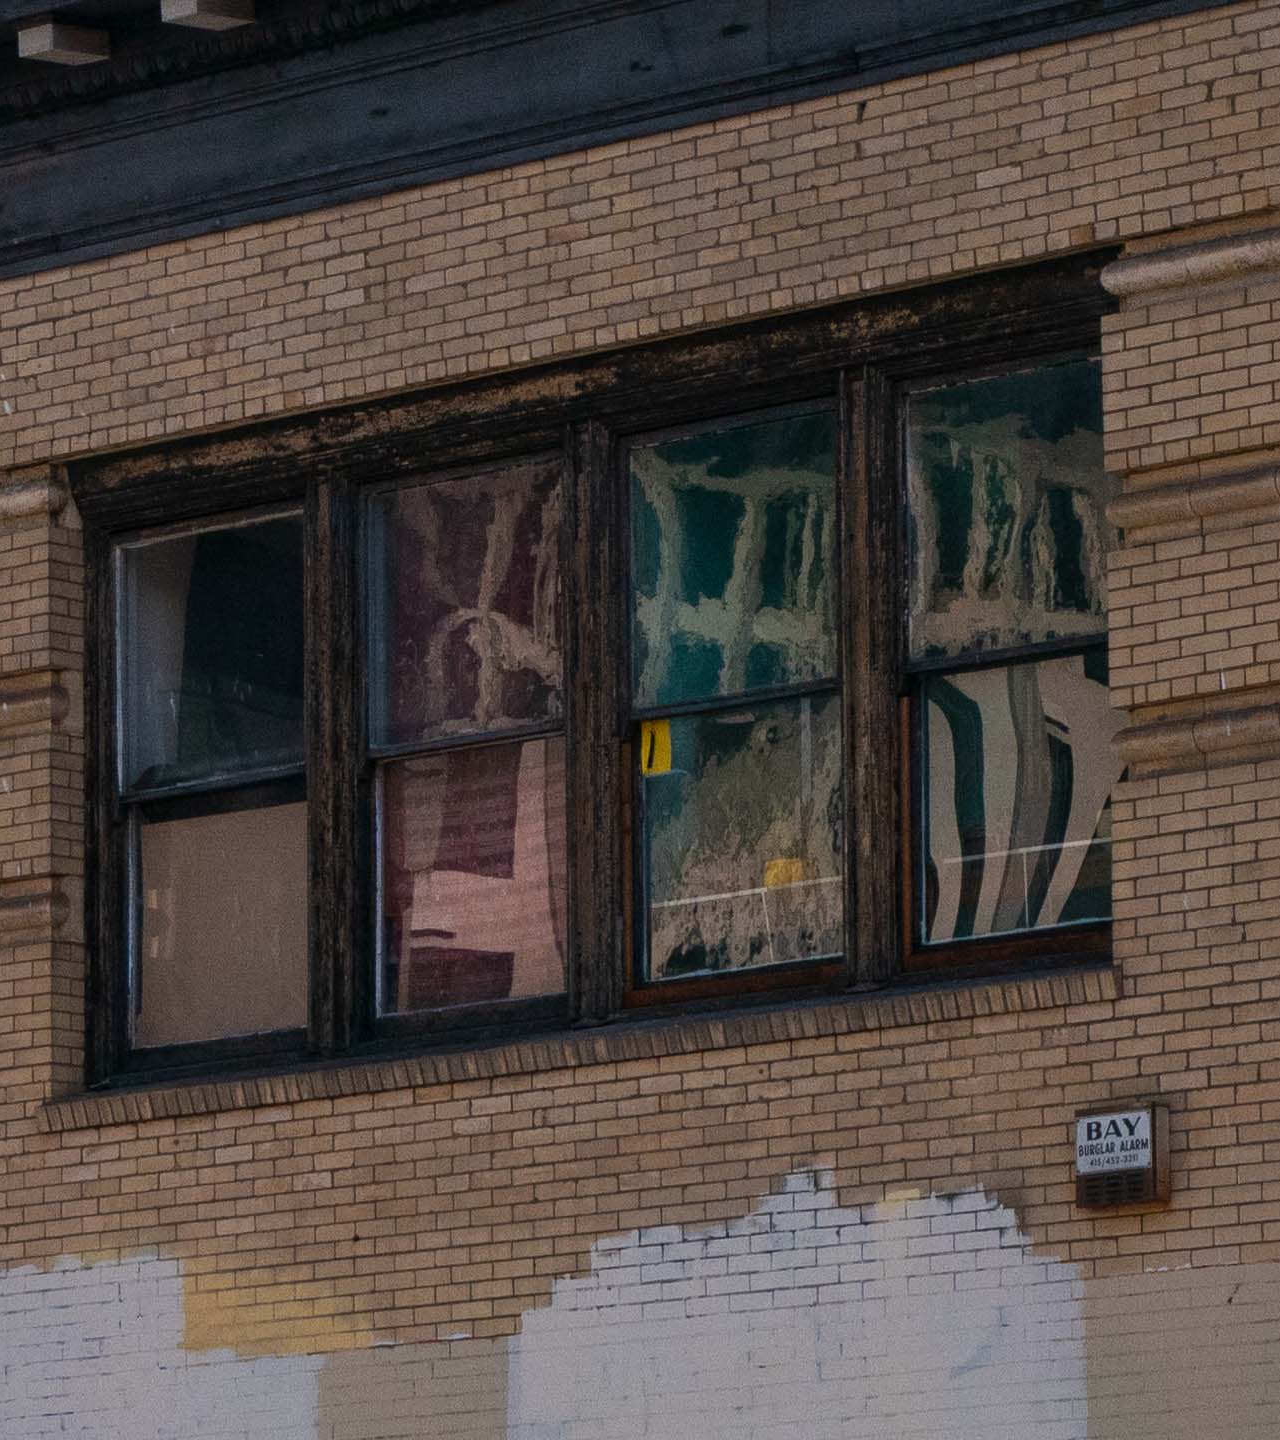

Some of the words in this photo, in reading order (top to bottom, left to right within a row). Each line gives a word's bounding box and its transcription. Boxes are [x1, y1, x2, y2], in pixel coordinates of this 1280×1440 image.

[1086, 1116, 1141, 1141] BAY
[1078, 1141, 1115, 1157] BURGLAR
[1119, 1138, 1149, 1152] ALARM
